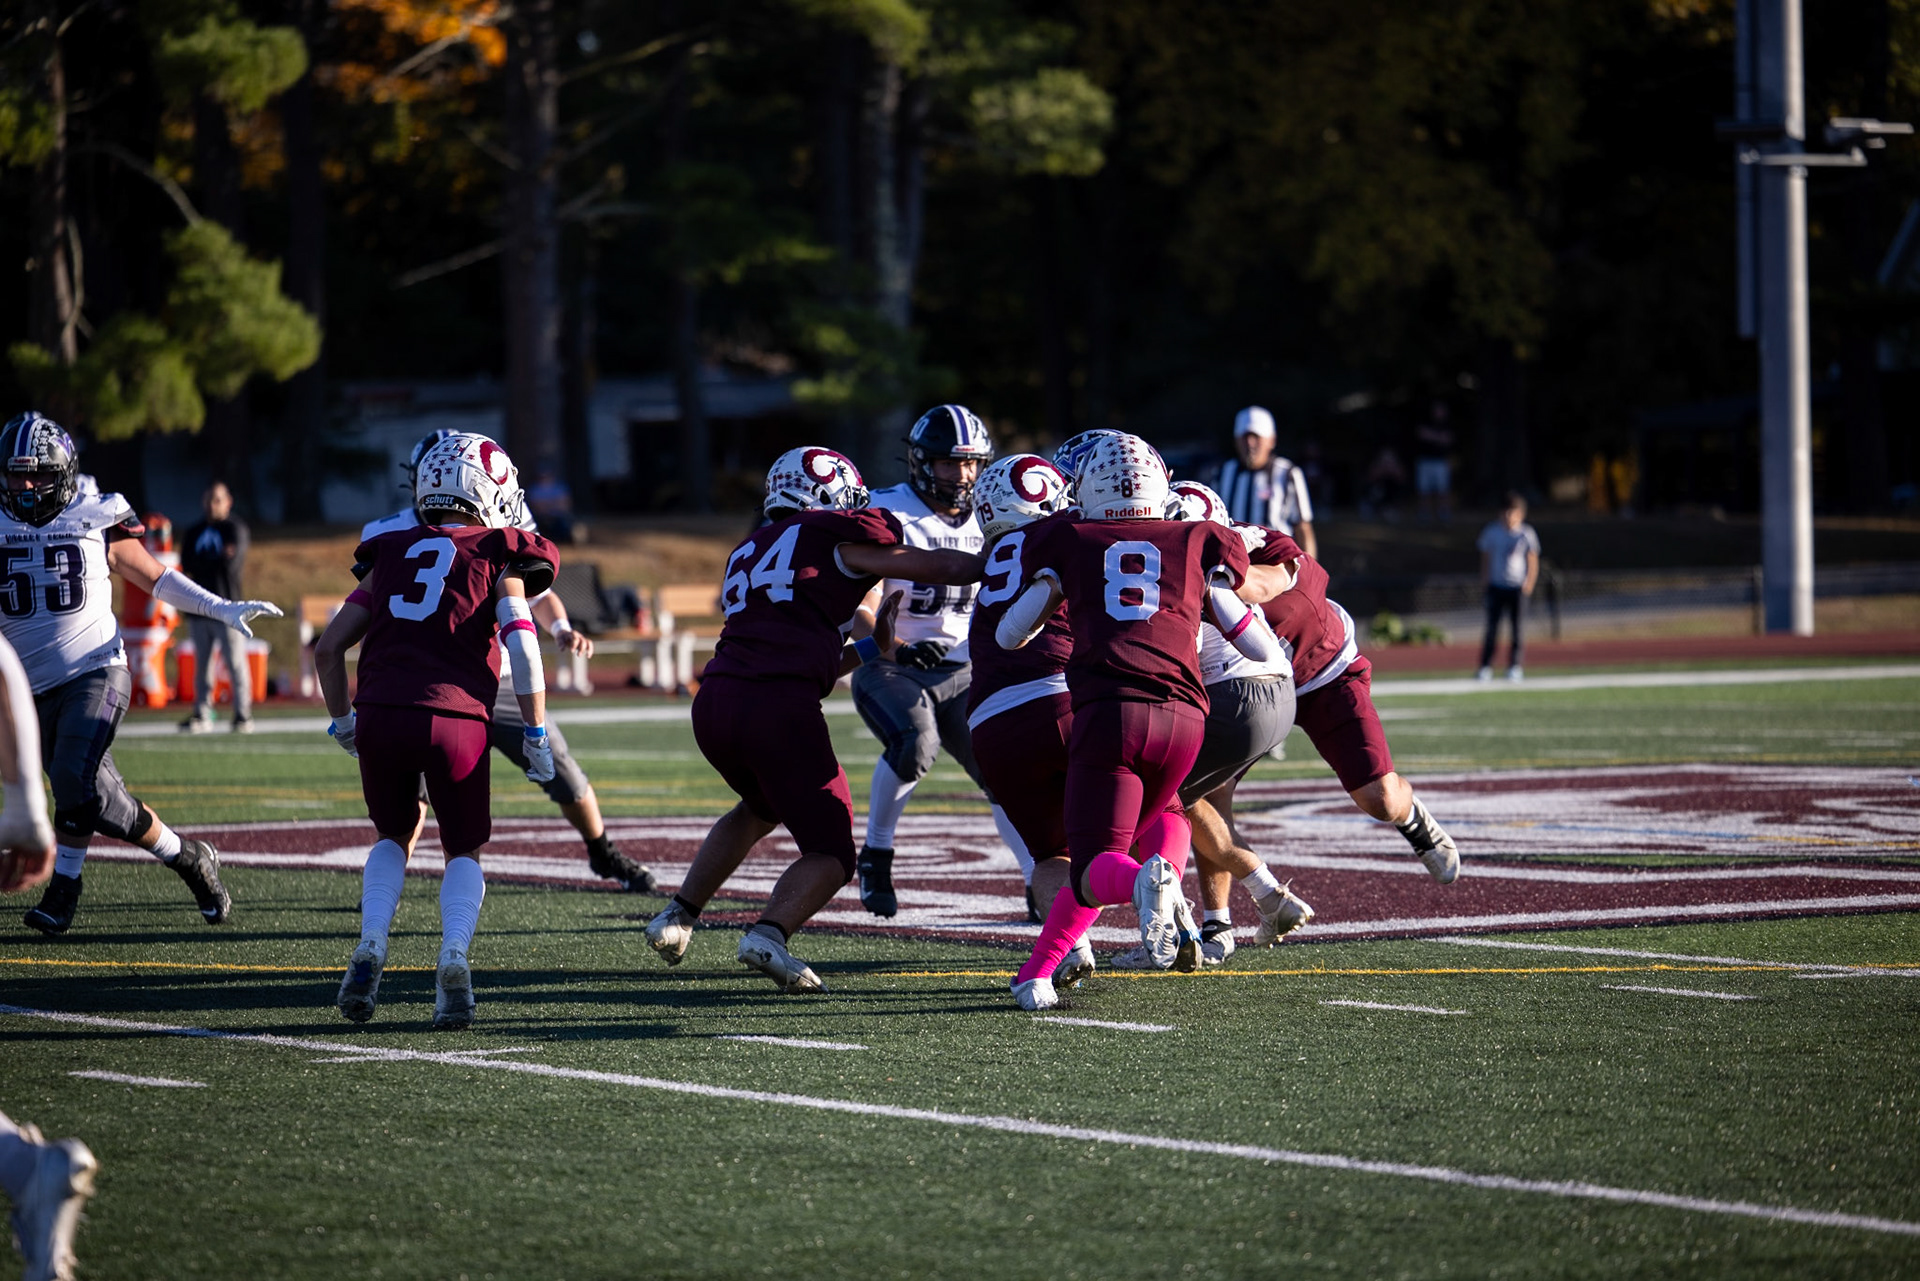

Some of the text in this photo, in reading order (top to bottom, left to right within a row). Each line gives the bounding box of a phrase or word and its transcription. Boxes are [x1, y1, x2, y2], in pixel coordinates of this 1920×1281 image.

[431, 468, 442, 488] 3
[1121, 478, 1133, 498] 8
[425, 494, 454, 505] schutt
[977, 502, 994, 525] 79
[1104, 506, 1152, 519] Riddell
[0, 544, 87, 620] 53
[389, 537, 457, 622] 3
[721, 523, 802, 618] 64
[1104, 540, 1161, 621] 8
